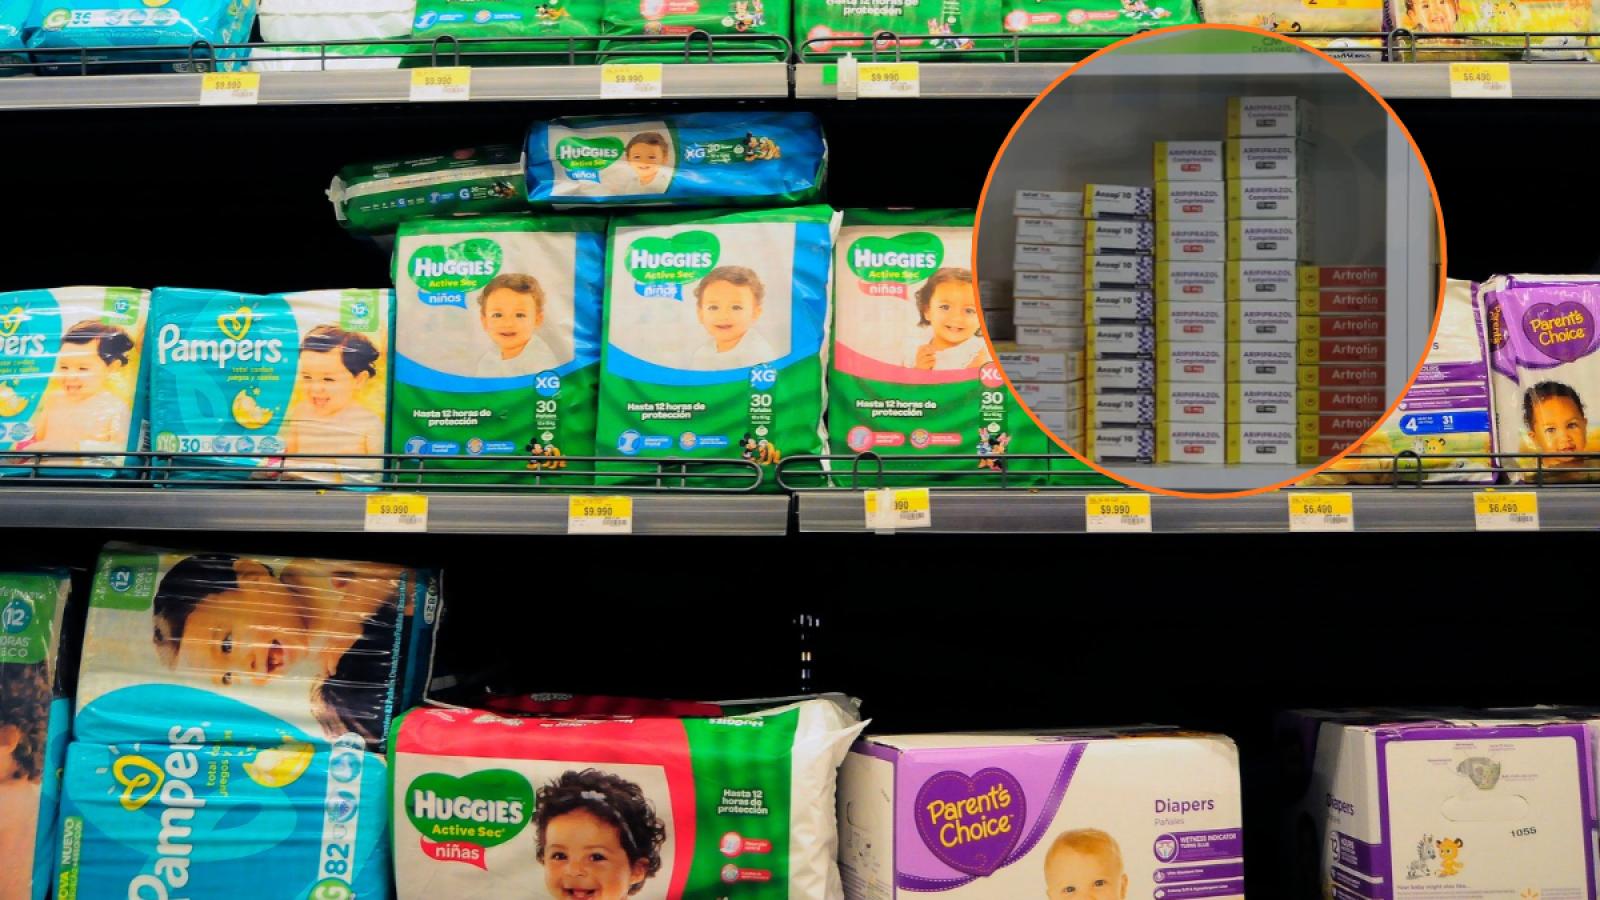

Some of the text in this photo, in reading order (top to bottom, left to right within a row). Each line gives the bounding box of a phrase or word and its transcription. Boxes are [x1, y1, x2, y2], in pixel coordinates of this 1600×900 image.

[560, 145, 619, 160] HUGGIES
[572, 170, 596, 179] niños
[631, 250, 712, 268] HUGGIES
[854, 248, 936, 269] HUGGIES
[415, 258, 494, 277] HUGGIES
[645, 271, 674, 280] Active
[868, 270, 920, 279] Active Sec
[429, 278, 458, 288] Active
[869, 283, 903, 294] niñas
[429, 293, 461, 303] niños
[1530, 310, 1584, 332] Parent's
[1539, 327, 1585, 346] Choice
[0, 335, 46, 356] ers
[158, 324, 282, 368] Pampers
[536, 376, 560, 388] XG
[751, 370, 776, 382] XG
[751, 394, 772, 406] 30
[982, 392, 1003, 404] 30
[536, 400, 556, 412] 30
[642, 411, 691, 420] protección
[872, 408, 922, 417] protección
[428, 418, 478, 427] protección
[1405, 417, 1418, 431] 4
[1442, 416, 1453, 424] 31
[181, 439, 200, 452] 30
[380, 505, 408, 514] $9.990
[584, 507, 612, 516] $9.990
[1100, 505, 1130, 515] $9.990
[1304, 504, 1332, 514] $6.490
[1489, 504, 1518, 513] $6.490
[7, 608, 24, 626] 12
[0, 637, 30, 648] ORAS
[1, 648, 28, 657] ECO
[208, 760, 216, 786] total
[221, 760, 229, 797] juegos
[724, 789, 762, 799] Hasta 12
[414, 790, 524, 824] HUGGIES
[718, 805, 768, 814] protección
[927, 784, 1011, 824] Parent's
[1155, 799, 1214, 814] Diapers
[128, 725, 206, 900] Pampers
[432, 825, 502, 837] Active Sec
[940, 815, 1011, 848] Choice
[1511, 826, 1537, 837] 1055
[62, 818, 74, 865] NUEVO
[436, 845, 479, 859] niñas
[324, 842, 349, 876] 82
[58, 872, 69, 898] OVA
